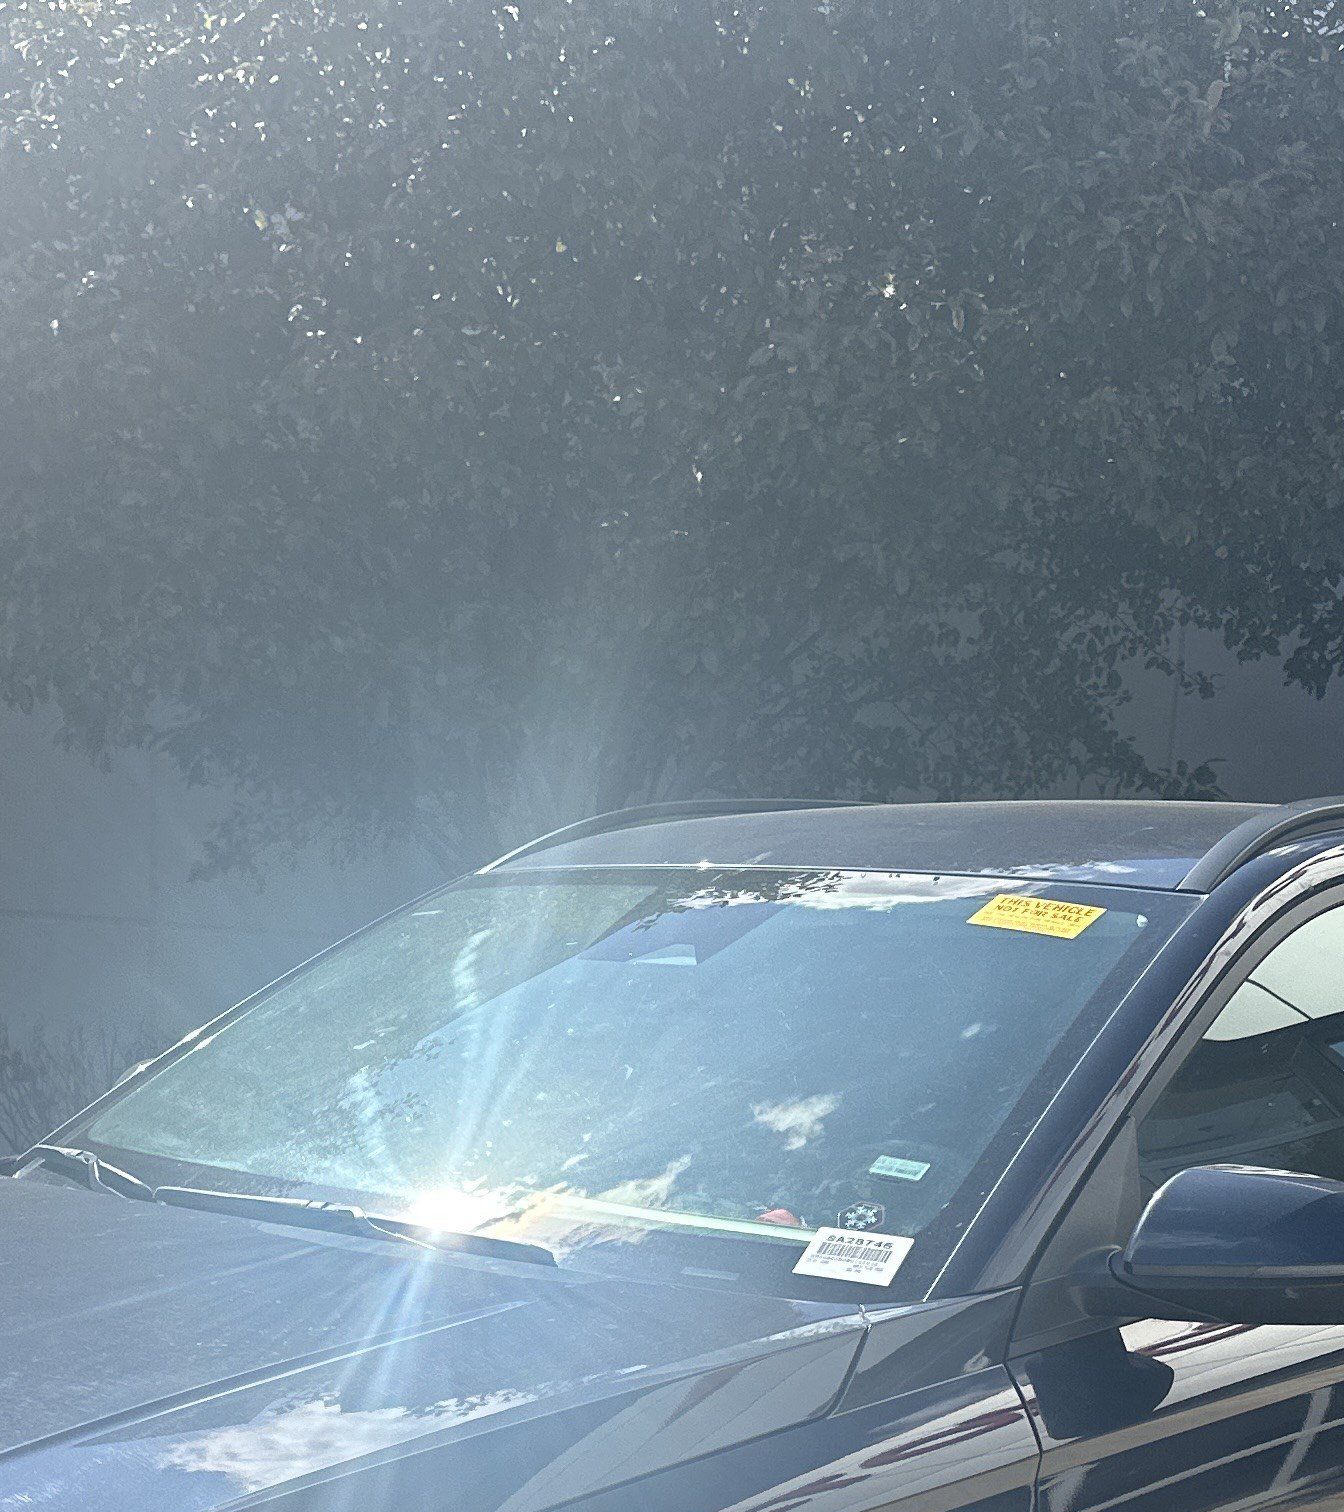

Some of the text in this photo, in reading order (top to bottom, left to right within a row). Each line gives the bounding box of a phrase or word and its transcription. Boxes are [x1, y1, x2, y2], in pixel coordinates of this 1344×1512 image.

[995, 904, 1019, 913] NOT
[1051, 913, 1084, 923] SALE
[1000, 897, 1097, 917] THIS VEHICLE
